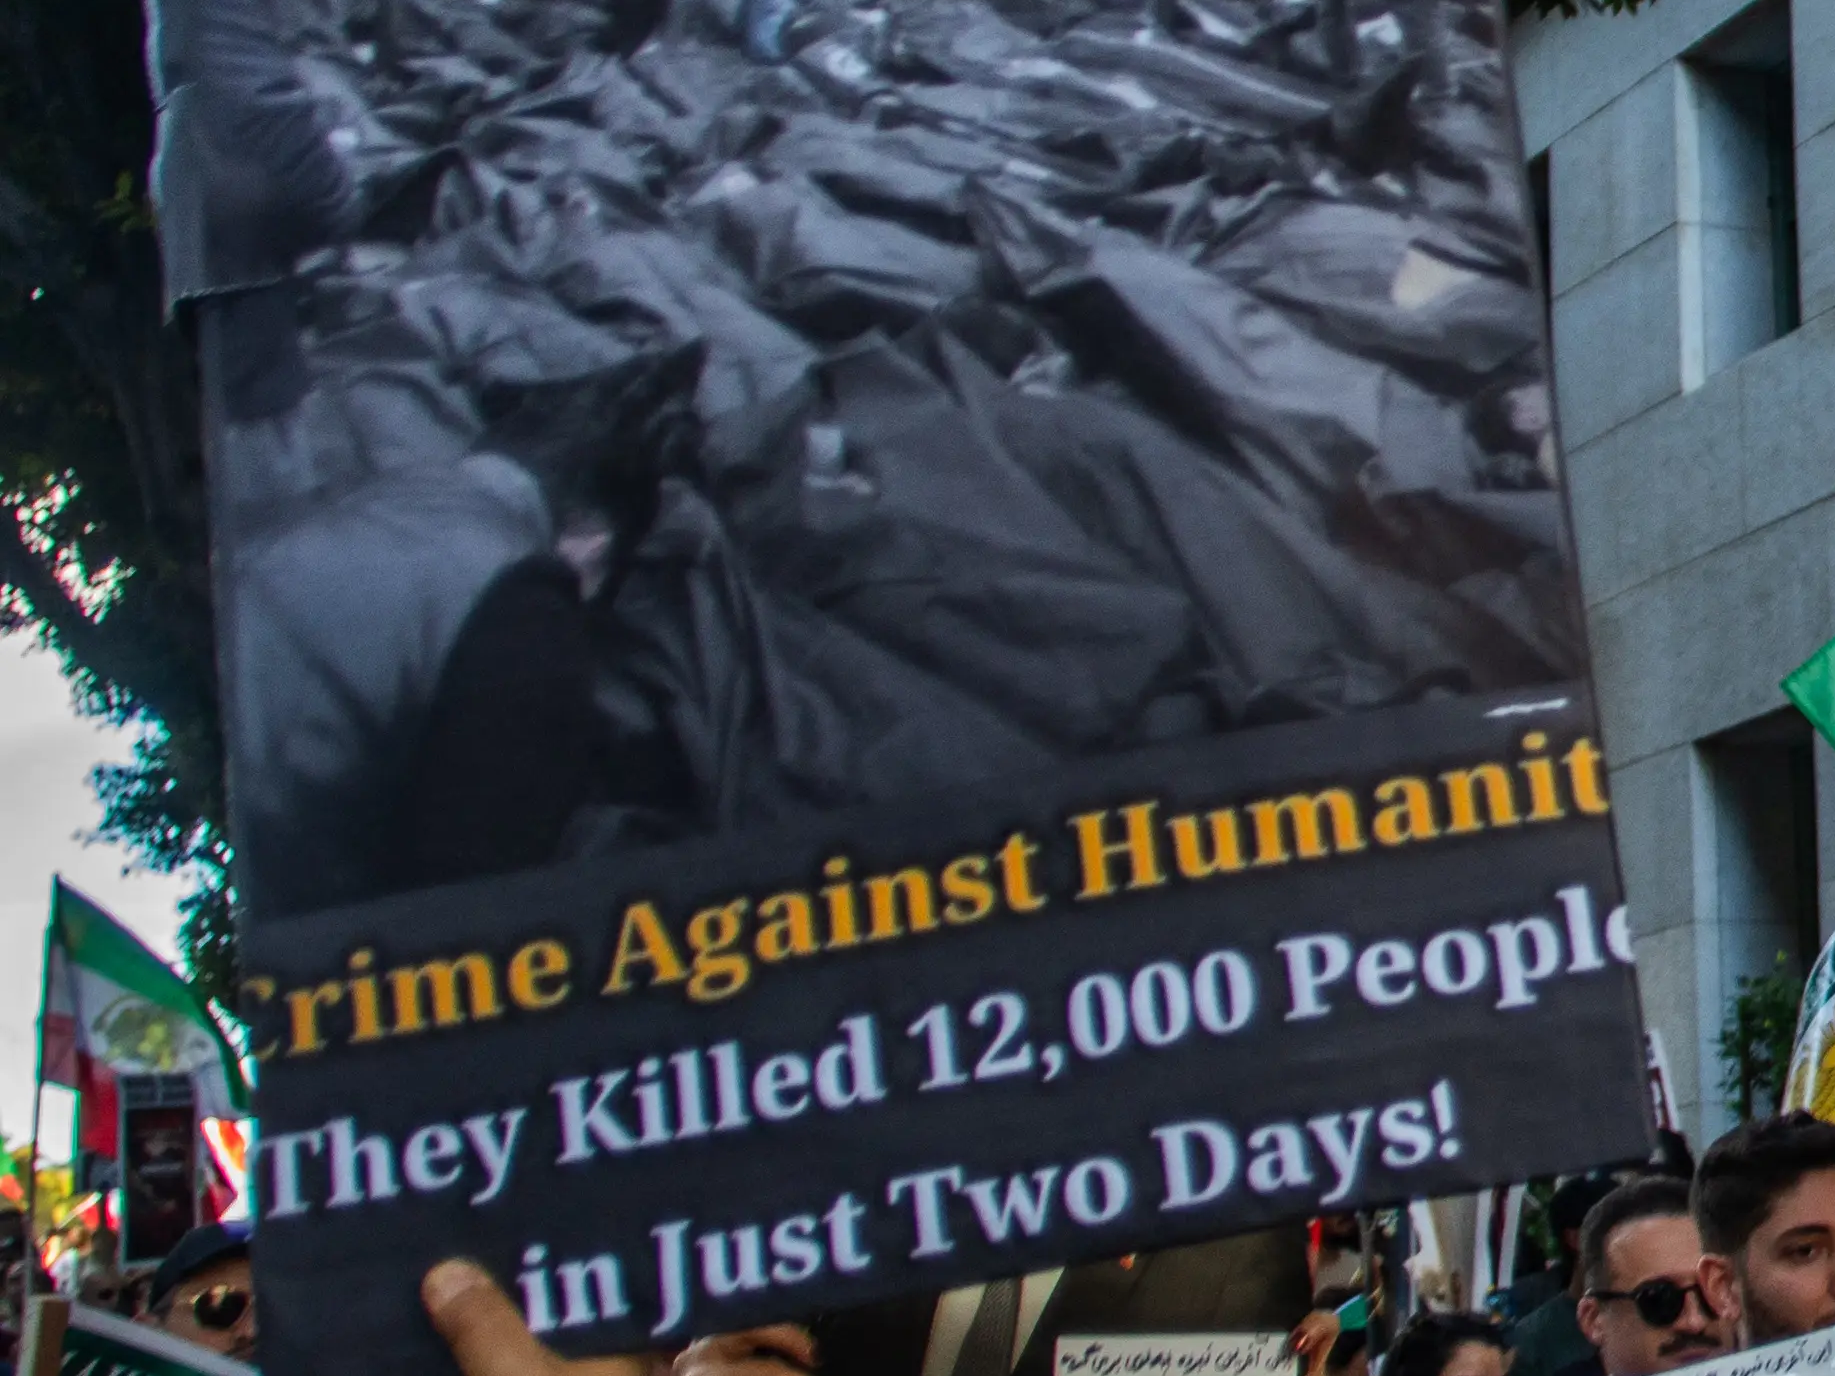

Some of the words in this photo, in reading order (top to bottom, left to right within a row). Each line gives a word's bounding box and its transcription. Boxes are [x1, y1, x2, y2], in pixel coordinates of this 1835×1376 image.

[602, 830, 1047, 1003] Against
[1067, 730, 1609, 900] Humanit
[258, 1107, 528, 1220] They
[549, 1015, 887, 1166] Killed
[905, 950, 1257, 1092] 12,000
[516, 1244, 629, 1333] in
[648, 1185, 873, 1338] Just
[888, 1154, 1131, 1261] Two
[1151, 1078, 1462, 1210] Days!
